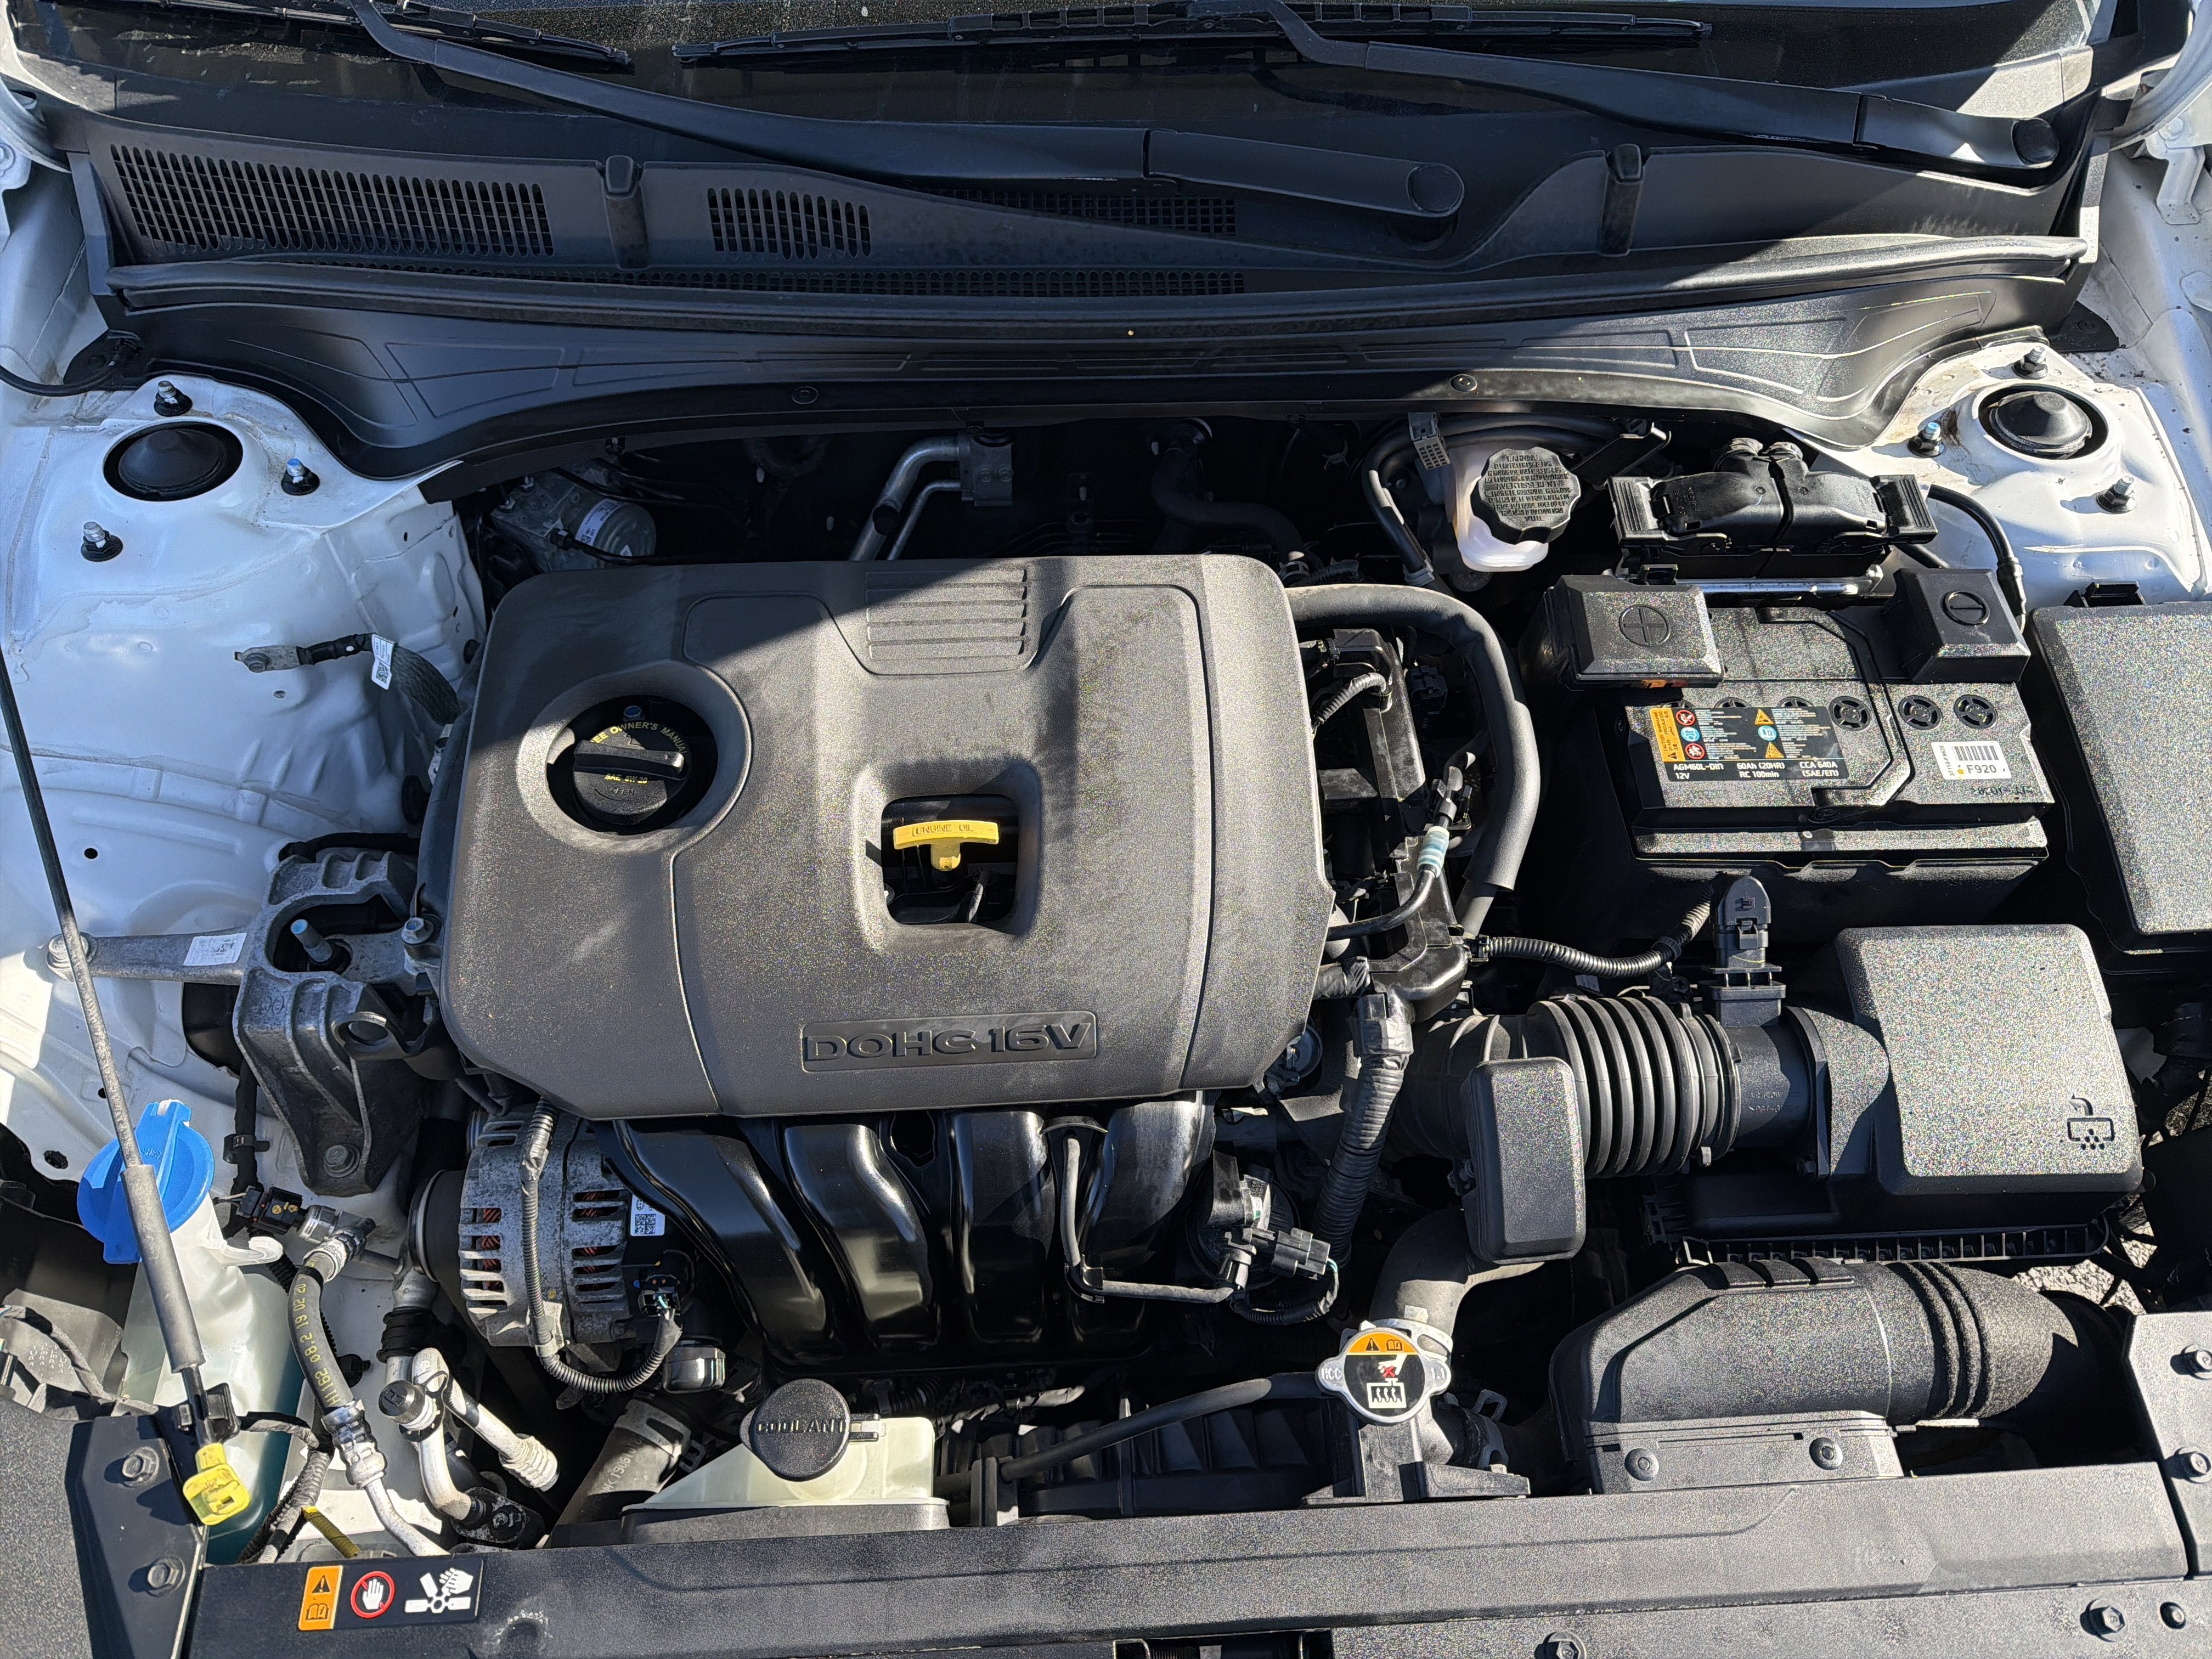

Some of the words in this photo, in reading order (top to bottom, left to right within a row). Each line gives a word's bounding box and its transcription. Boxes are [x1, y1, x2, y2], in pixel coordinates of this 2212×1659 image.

[590, 731, 608, 744] EE
[610, 721, 659, 734] OWNER'S
[1758, 761, 1785, 769] (20HR)
[1966, 764, 1997, 774] F920
[605, 774, 622, 782] SAE
[624, 775, 648, 785] 5W-20
[958, 824, 975, 832] OIL
[805, 1028, 977, 1062] DOHC
[989, 1022, 1092, 1053] 16V
[293, 1283, 307, 1295] 20
[292, 1297, 306, 1312] 02
[295, 1314, 309, 1329] 19
[1430, 1367, 1446, 1380] 1.1
[755, 1419, 844, 1435] COOLANT
